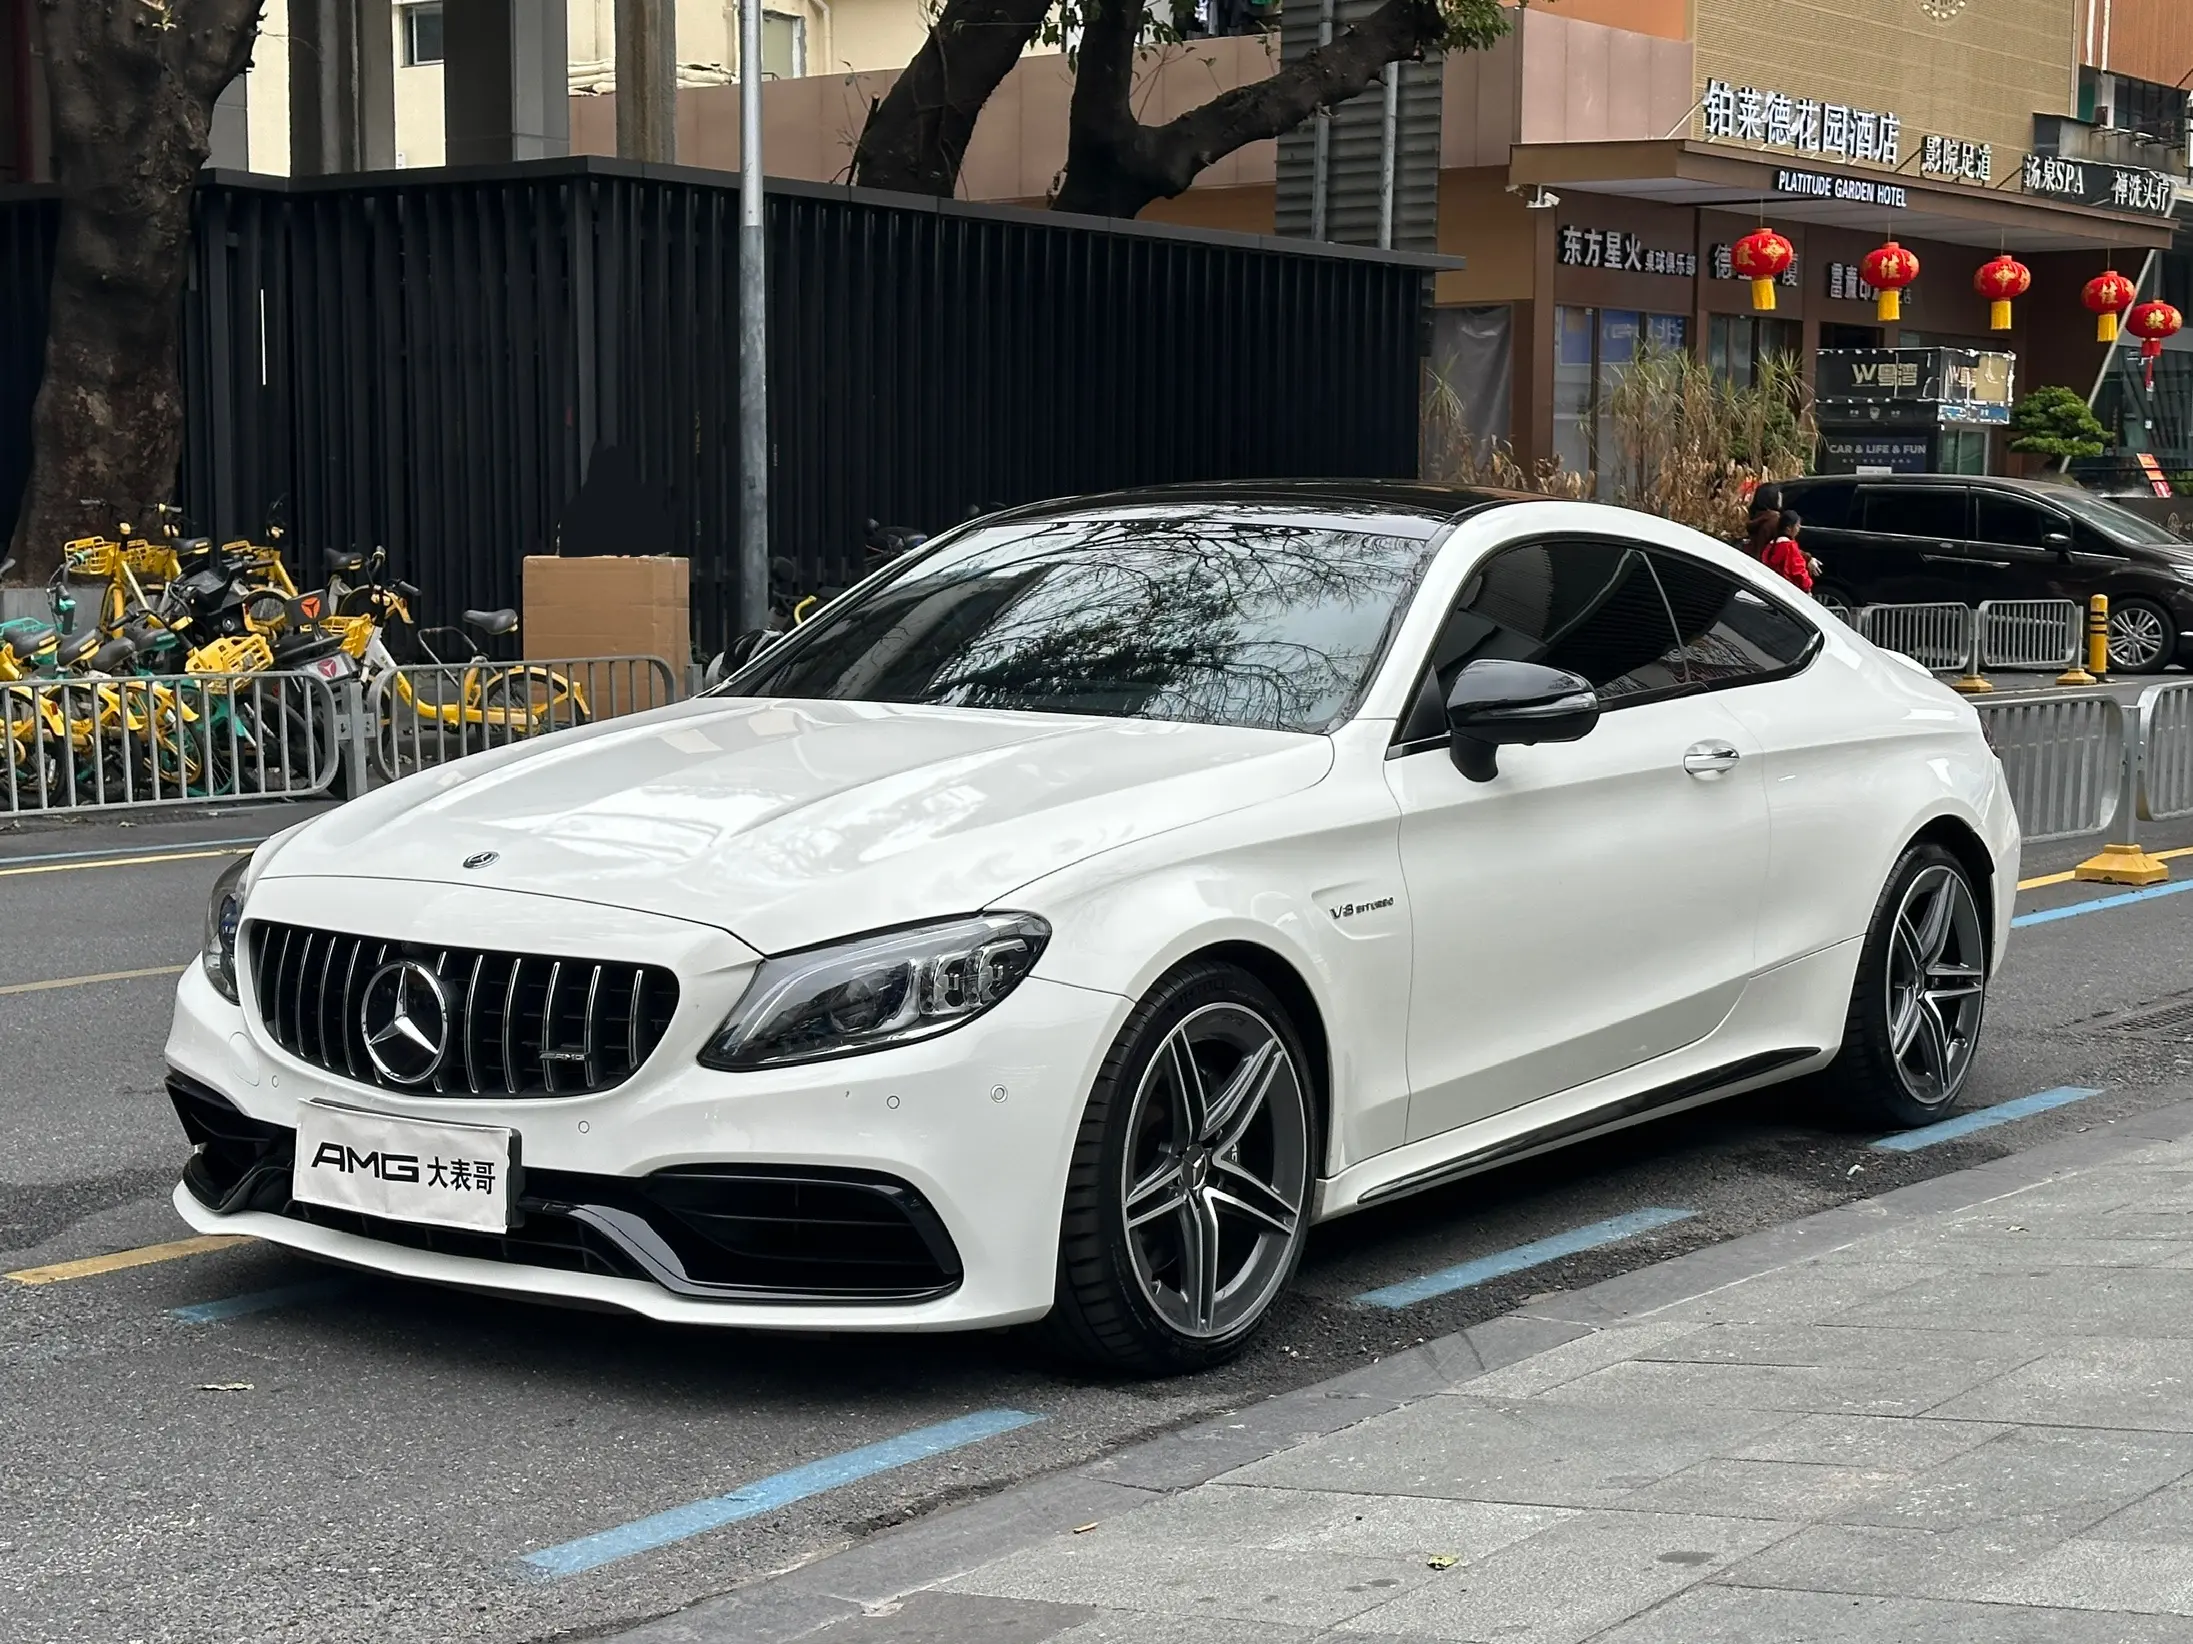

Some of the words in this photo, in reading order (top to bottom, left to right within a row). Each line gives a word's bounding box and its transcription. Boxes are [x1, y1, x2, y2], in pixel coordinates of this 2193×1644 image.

[1703, 78, 1900, 165] 铂莱德花园酒店
[1921, 135, 1992, 181] 影院足道
[1778, 170, 1832, 197] PLATITUDE
[1835, 178, 1874, 202] GARDEN
[1877, 184, 1907, 207] HOTEL
[1563, 225, 1642, 271] 东方星火
[1830, 444, 1853, 454] CAR
[1855, 444, 1863, 454] &
[1866, 444, 1890, 454] LIFE
[1892, 444, 1900, 454] &
[1903, 444, 1926, 454] FUN
[1329, 903, 1354, 920] V8
[311, 1141, 420, 1183] AMG
[427, 1156, 496, 1195] 大表哥
